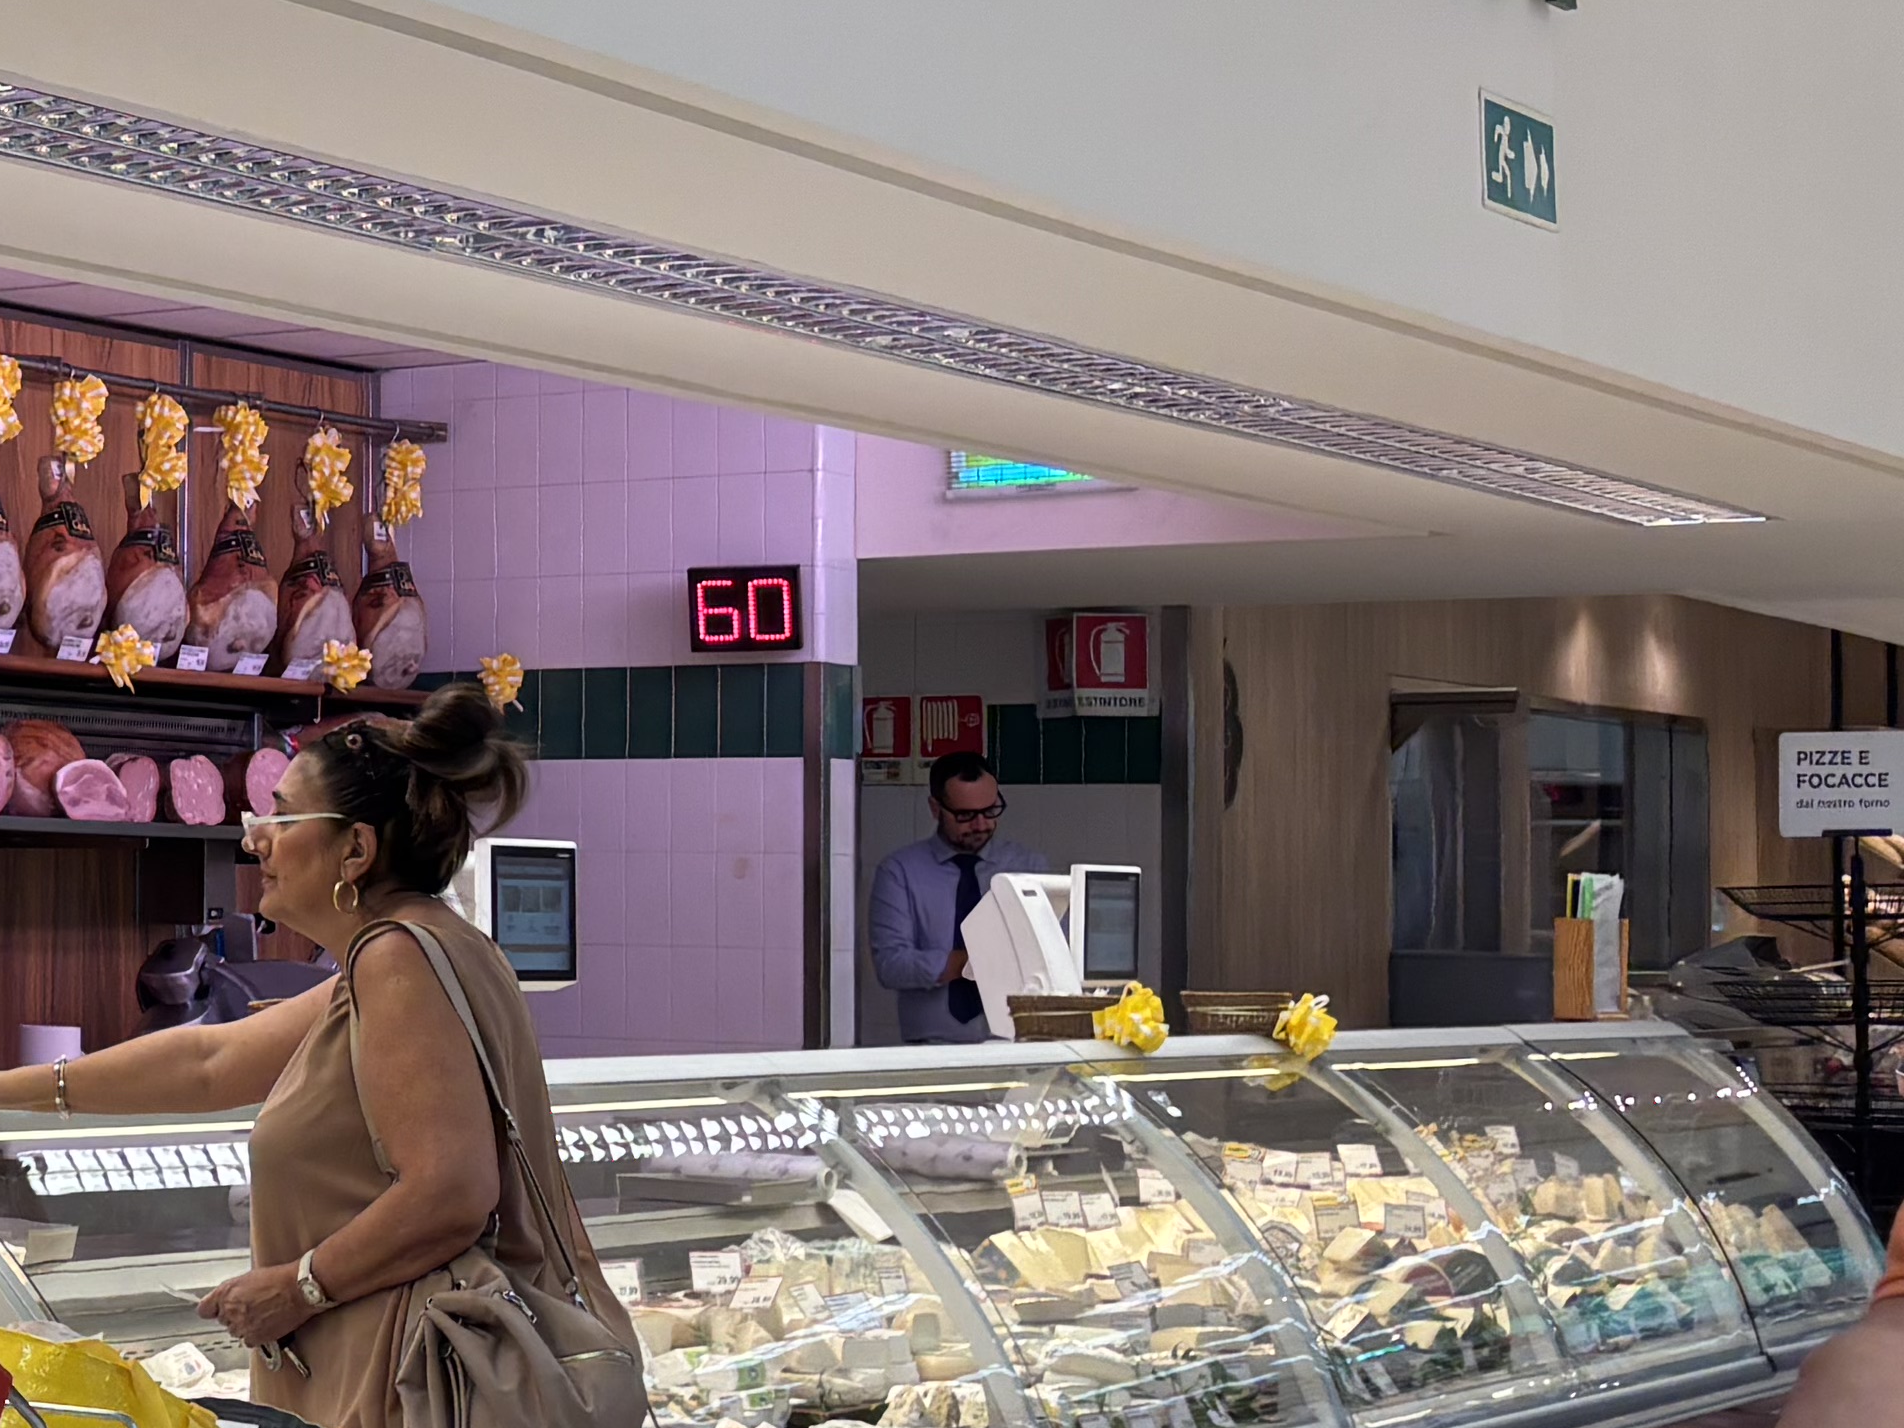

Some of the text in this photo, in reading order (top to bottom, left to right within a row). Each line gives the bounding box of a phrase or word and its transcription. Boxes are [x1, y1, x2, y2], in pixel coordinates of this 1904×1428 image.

[696, 577, 792, 644] 60
[1076, 696, 1146, 708] ESTINTORE
[1797, 750, 1870, 766] PIZZE E
[1797, 773, 1890, 789] FOCACCE
[1796, 799, 1814, 809] dal
[1859, 798, 1890, 810] forno
